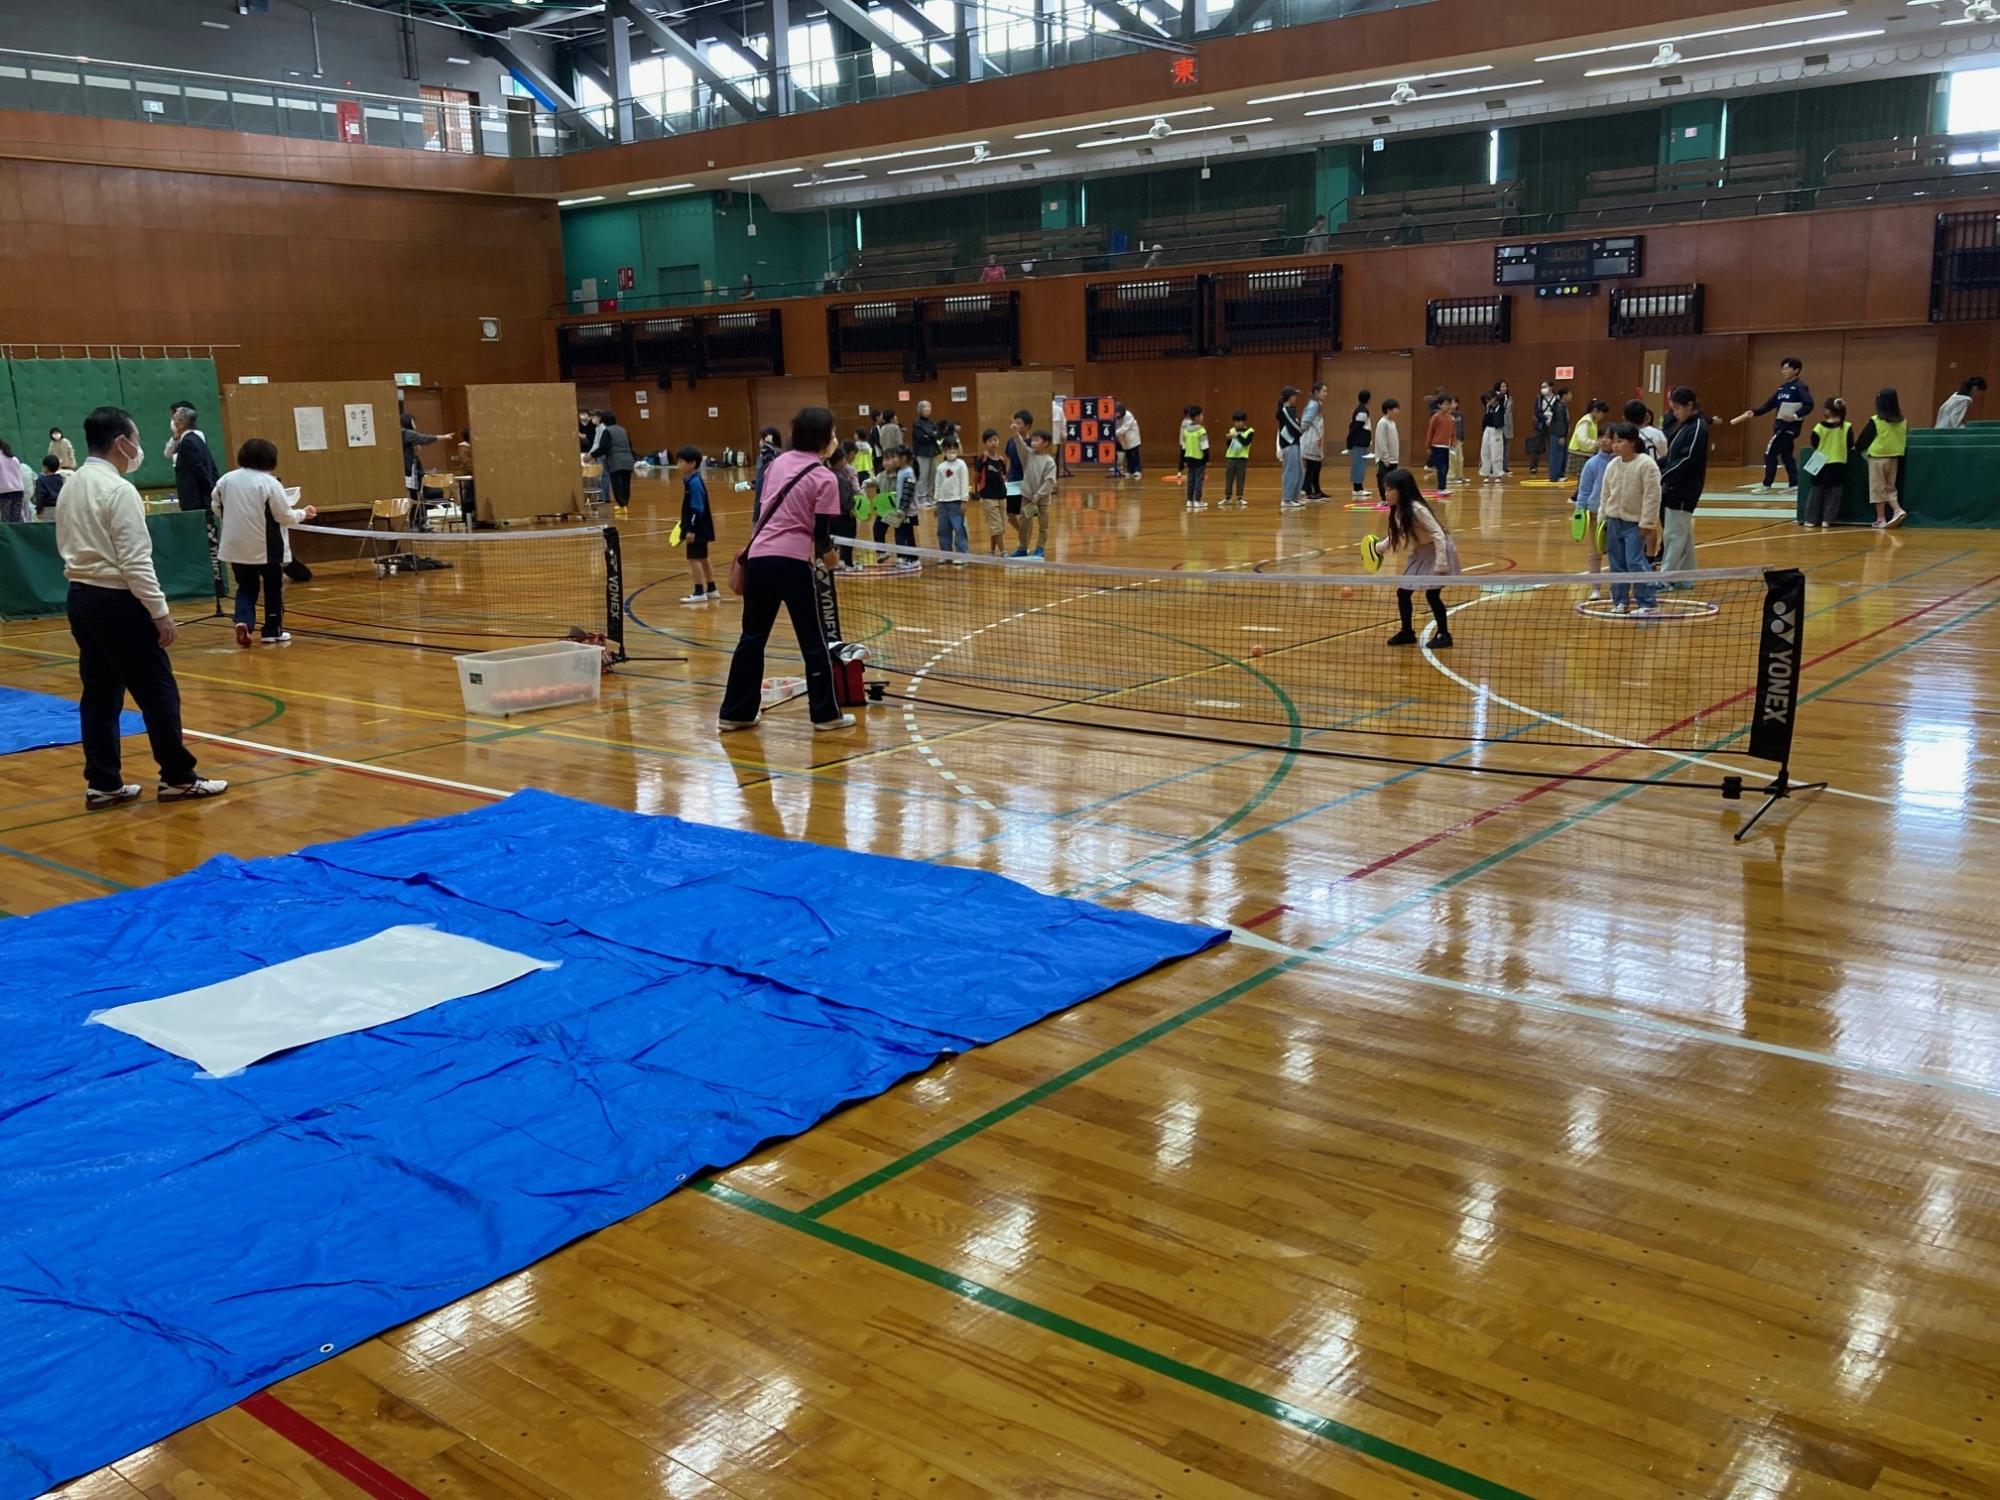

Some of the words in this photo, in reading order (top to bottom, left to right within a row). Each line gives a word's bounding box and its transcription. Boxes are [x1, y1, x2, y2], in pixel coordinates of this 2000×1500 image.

[1174, 57, 1195, 84] 東
[1085, 405, 1092, 415] 2
[1103, 405, 1109, 414] 3
[1068, 427, 1076, 437] 4
[1087, 427, 1092, 436] 5
[1103, 426, 1110, 437] 6
[1086, 448, 1093, 458] 8
[1104, 448, 1110, 458] 9
[608, 575, 621, 620] YONEX
[1762, 649, 1793, 725] YONEX
